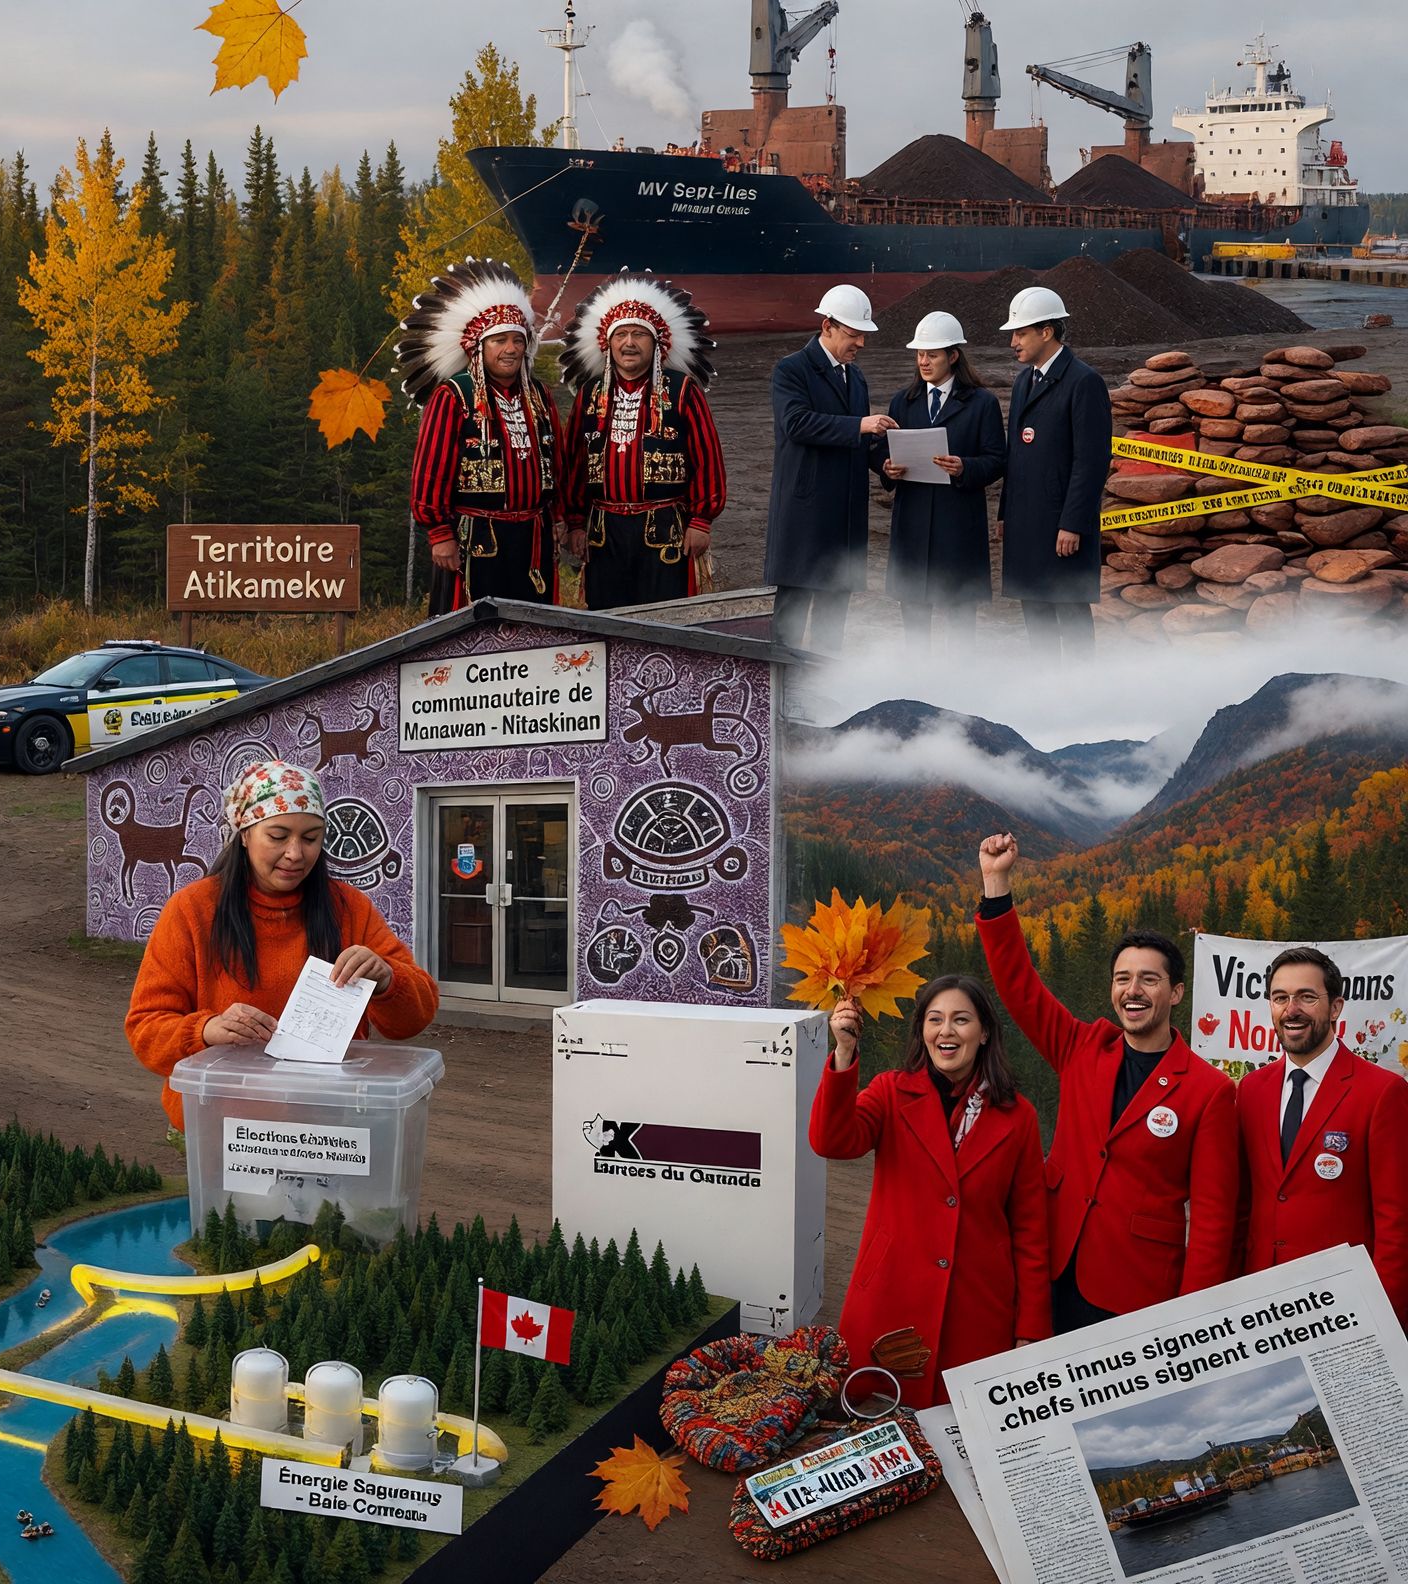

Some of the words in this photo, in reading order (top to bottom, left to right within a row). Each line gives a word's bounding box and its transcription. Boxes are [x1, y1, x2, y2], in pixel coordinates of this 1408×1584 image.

[638, 181, 669, 197] MV
[191, 534, 334, 564] Territoire
[183, 569, 346, 600] Atikamekw
[465, 661, 529, 684] Centre
[411, 686, 561, 715] communautaire
[568, 682, 593, 704] de
[502, 712, 601, 736] Nitaskinan
[988, 1371, 1062, 1406] Chefs
[1065, 1350, 1137, 1383] innus
[1141, 1317, 1236, 1359] signent
[1240, 1291, 1335, 1331] entente
[1078, 1374, 1150, 1408] innus
[1154, 1341, 1250, 1383] signent
[1254, 1312, 1359, 1354] entente:
